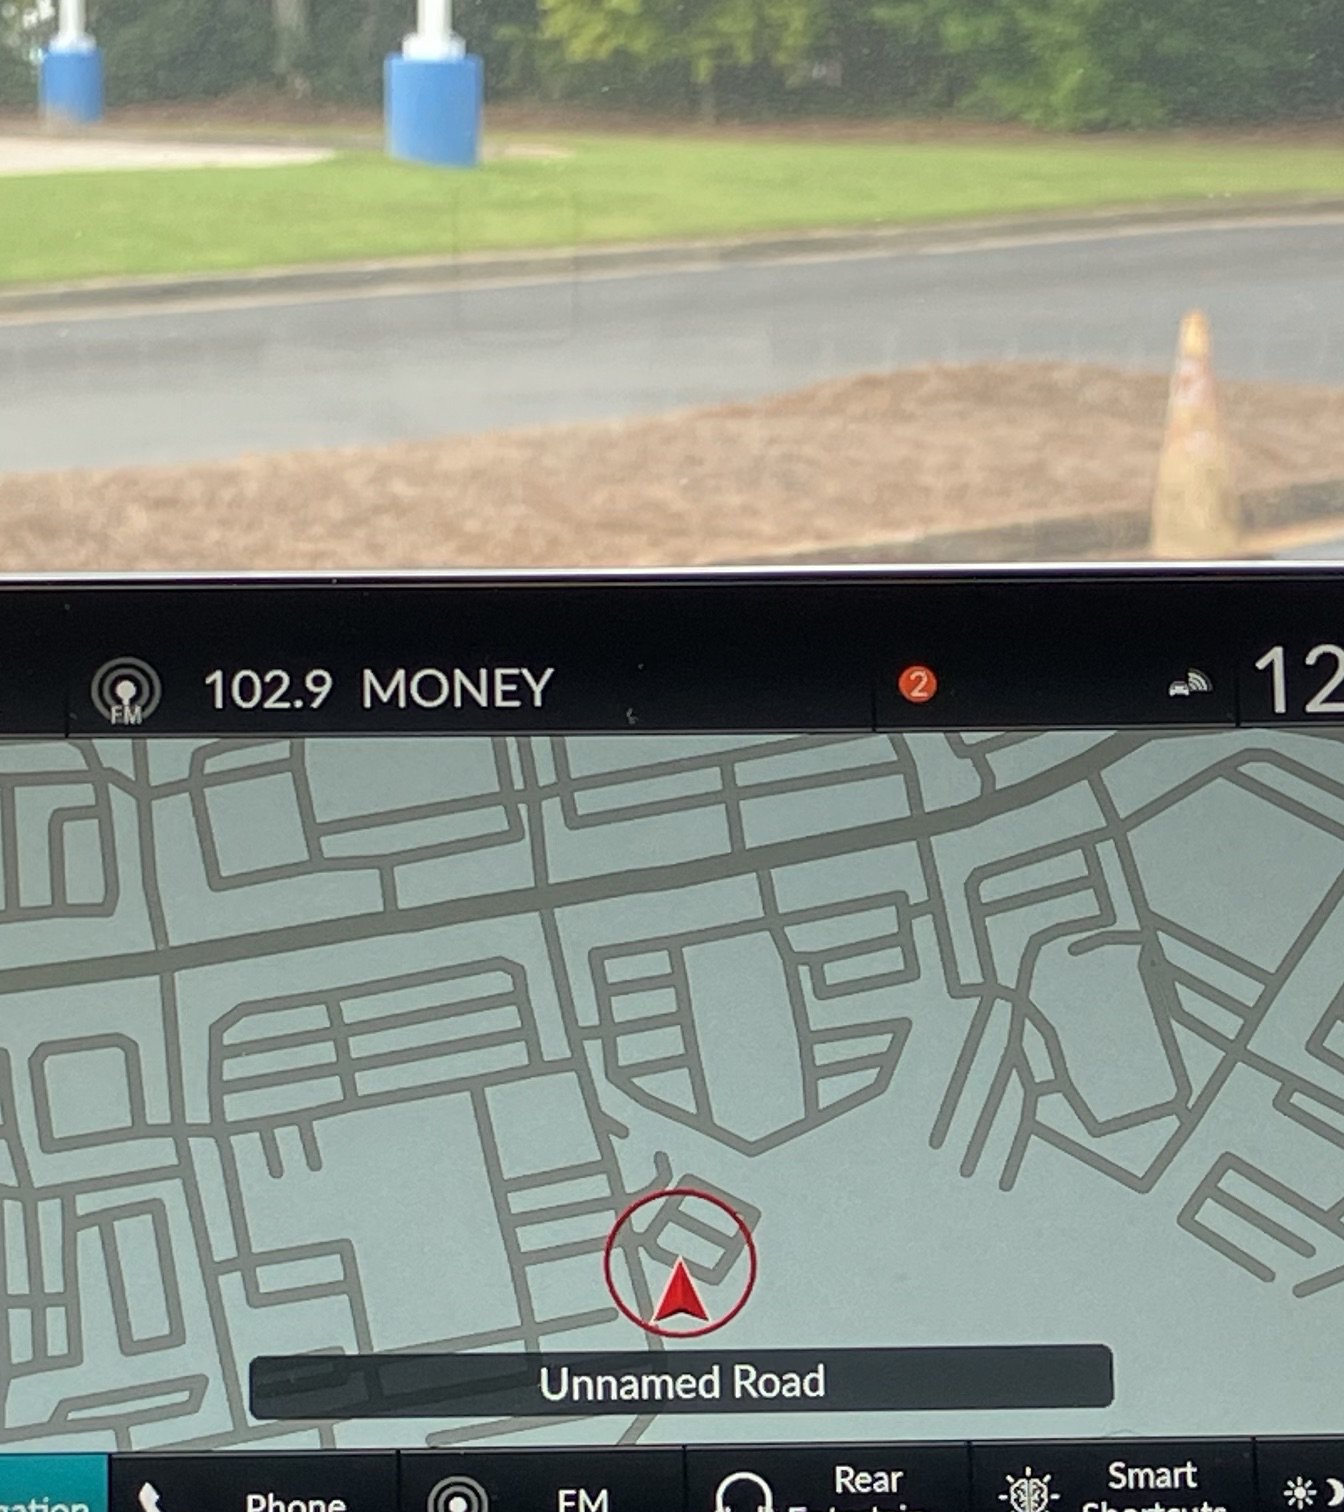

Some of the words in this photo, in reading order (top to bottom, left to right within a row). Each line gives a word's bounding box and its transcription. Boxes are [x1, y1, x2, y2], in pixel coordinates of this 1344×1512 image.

[205, 669, 333, 709] 102.9
[363, 667, 555, 709] MONEY
[910, 670, 928, 698] 2
[110, 702, 142, 725] FM
[540, 1364, 720, 1401] Unnamed
[733, 1363, 826, 1399] Road
[835, 1465, 904, 1494] Rear
[1108, 1460, 1198, 1490] Smart
